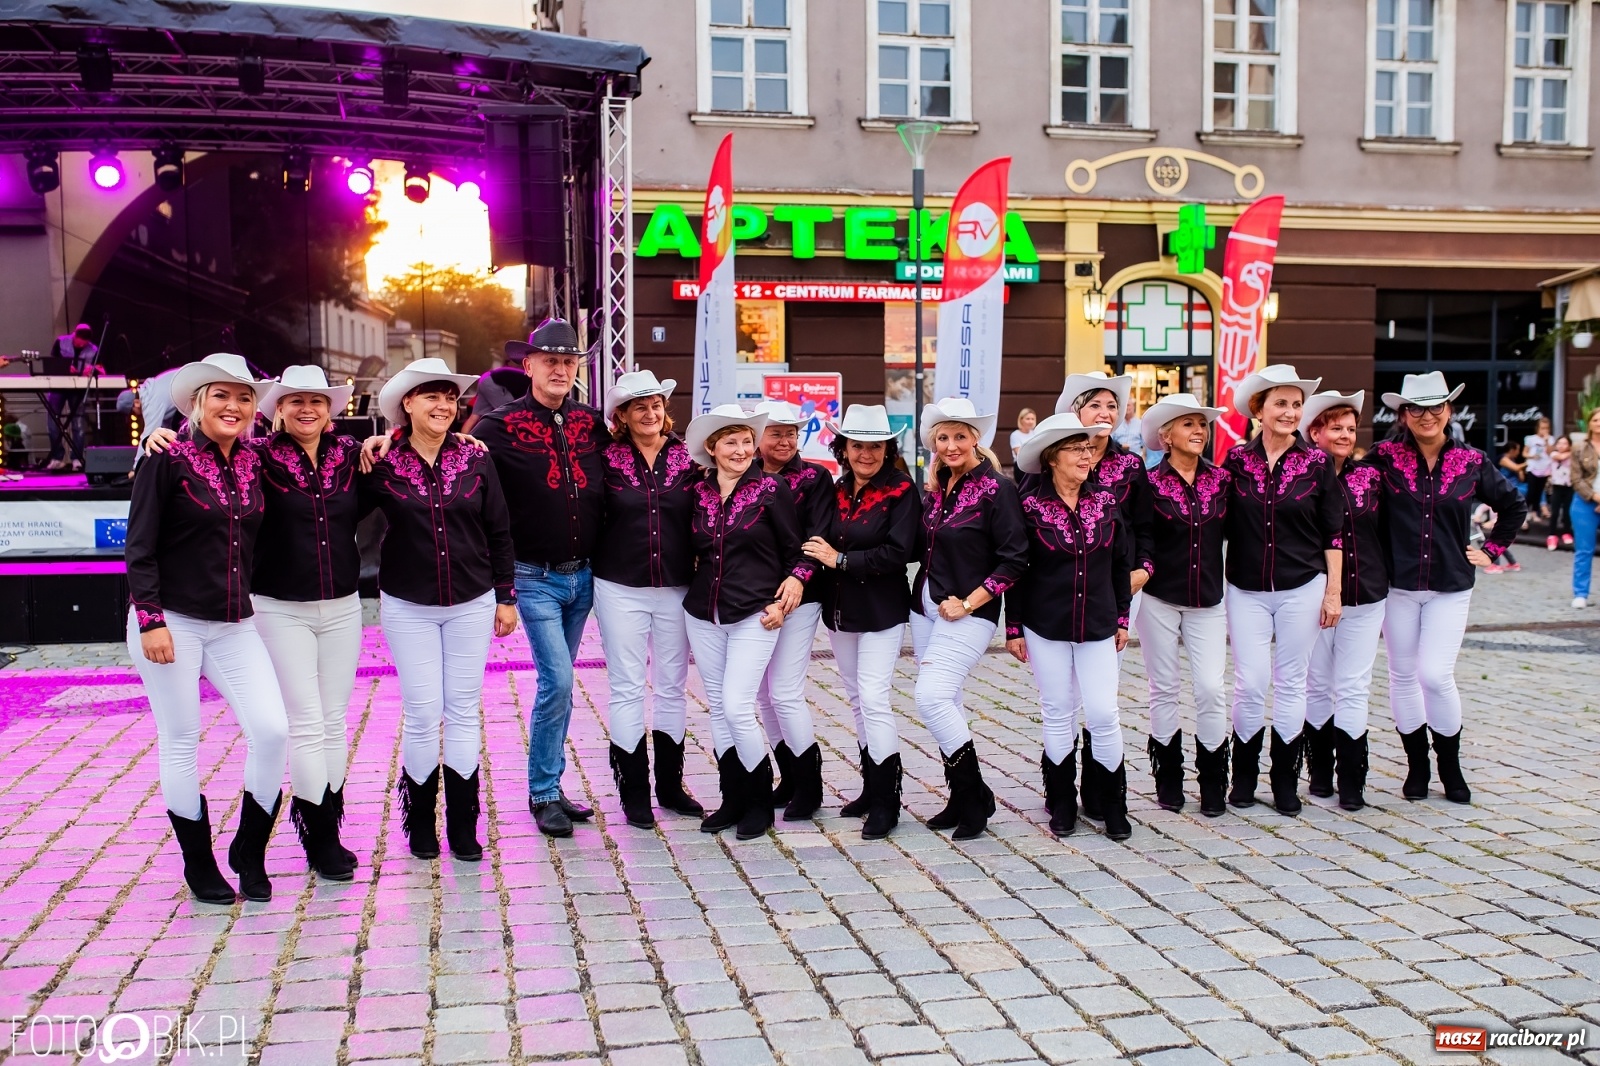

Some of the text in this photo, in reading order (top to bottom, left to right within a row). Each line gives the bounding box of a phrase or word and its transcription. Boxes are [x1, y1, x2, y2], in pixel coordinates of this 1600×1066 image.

[1155, 166, 1181, 179] 1953
[636, 203, 1040, 263] APTEKA
[956, 220, 999, 241] RV
[905, 265, 944, 279] POD
[741, 284, 762, 298] 12
[774, 285, 854, 300] CENTRUM
